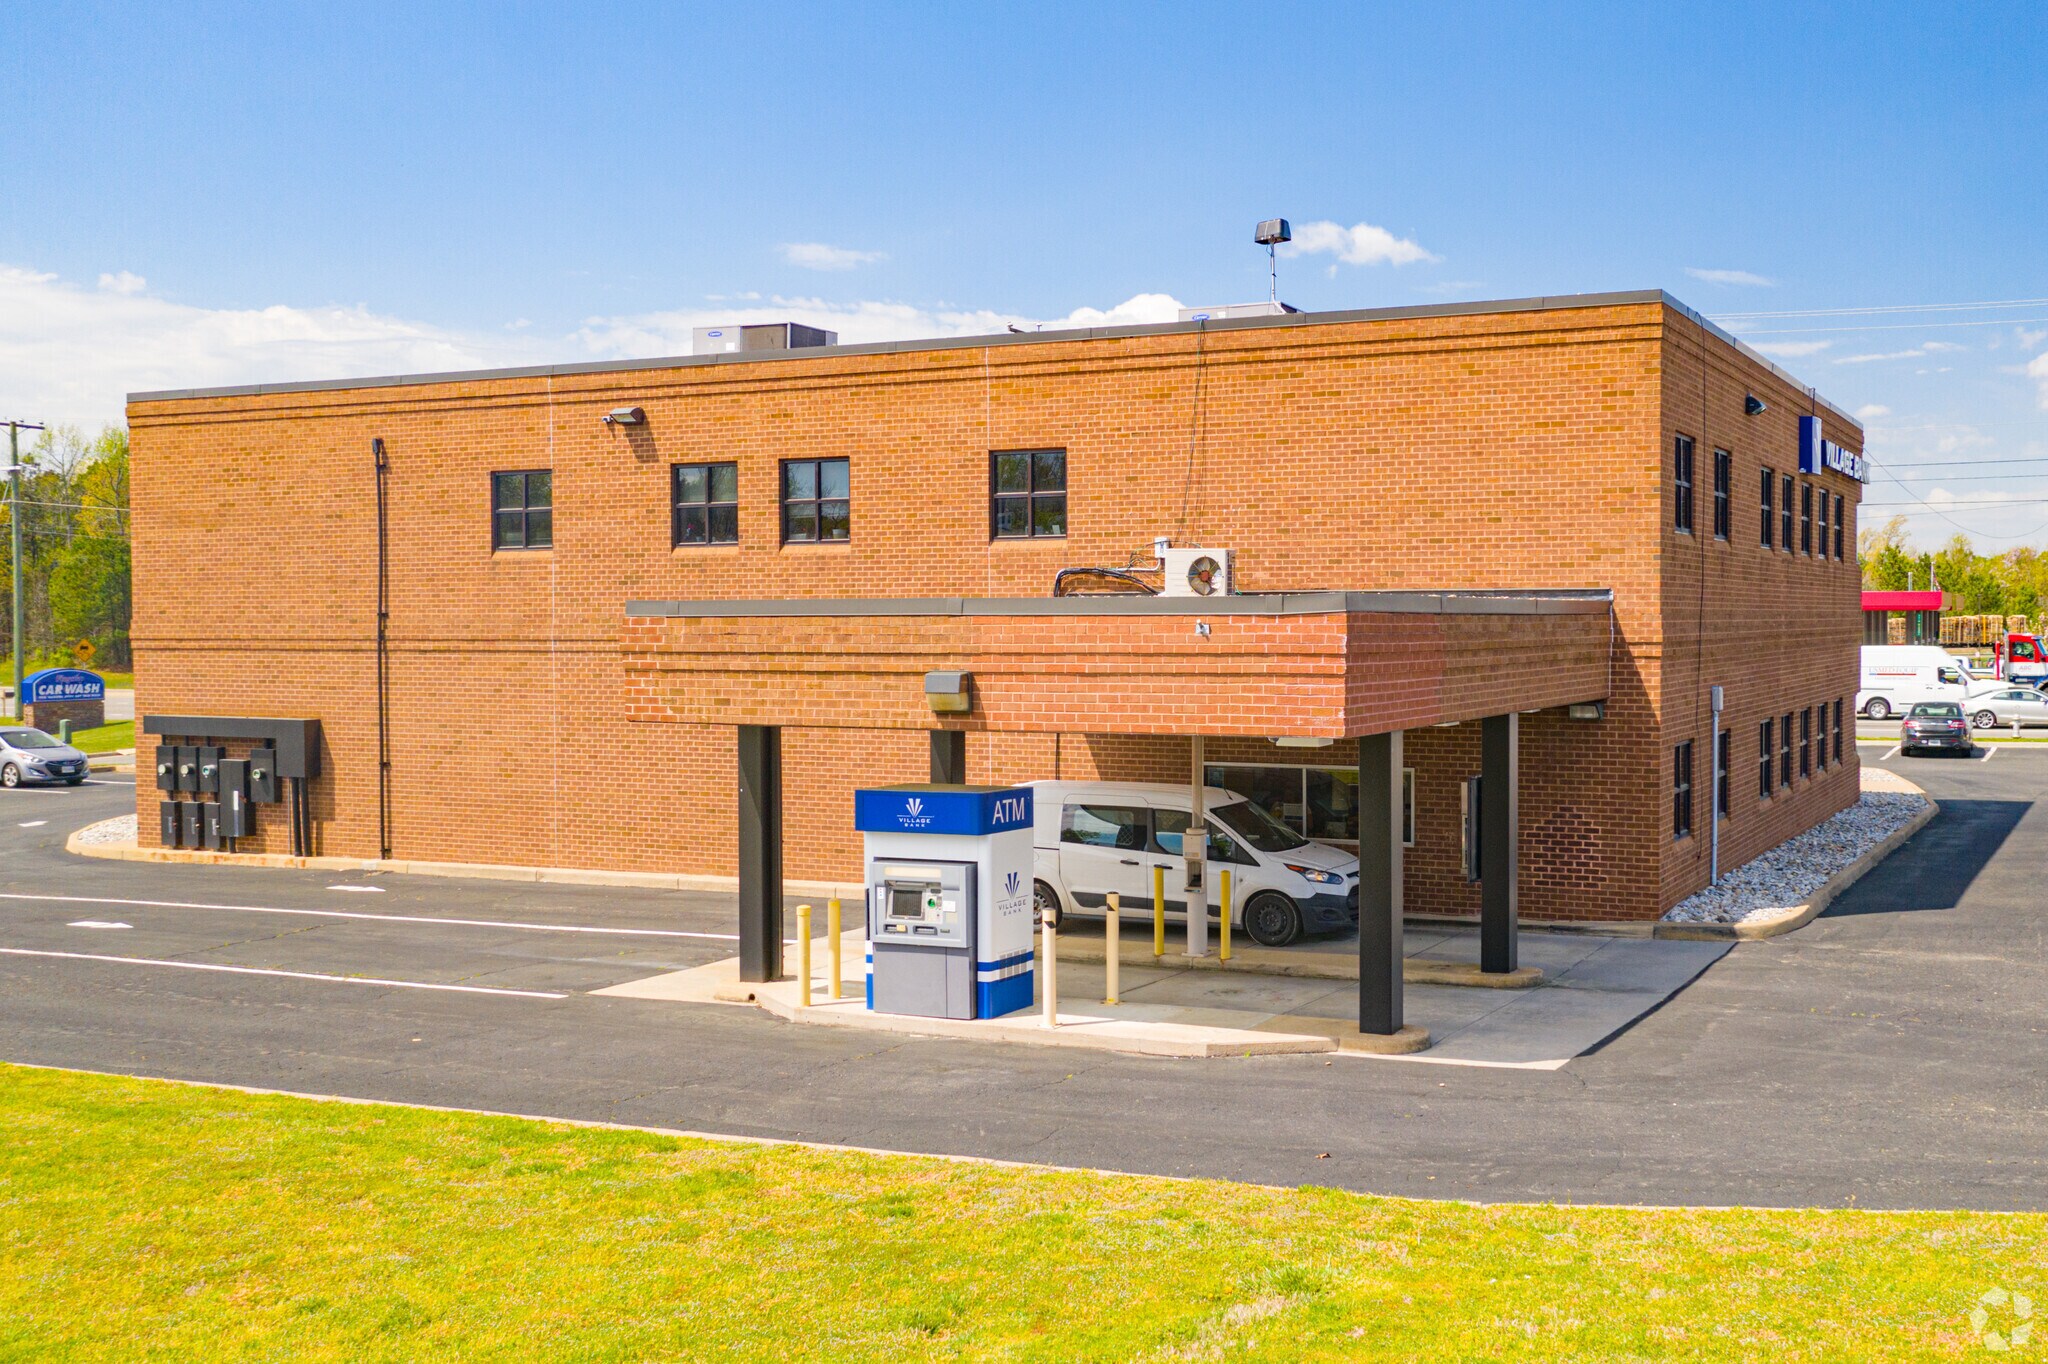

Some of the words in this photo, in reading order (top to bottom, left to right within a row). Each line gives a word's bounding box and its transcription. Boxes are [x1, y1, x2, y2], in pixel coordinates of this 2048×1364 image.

[38, 685, 63, 695] CAR
[65, 683, 100, 694] WASH
[992, 797, 1025, 825] ATM
[998, 899, 1026, 910] VILLAGE
[1003, 908, 1022, 917] BANK
